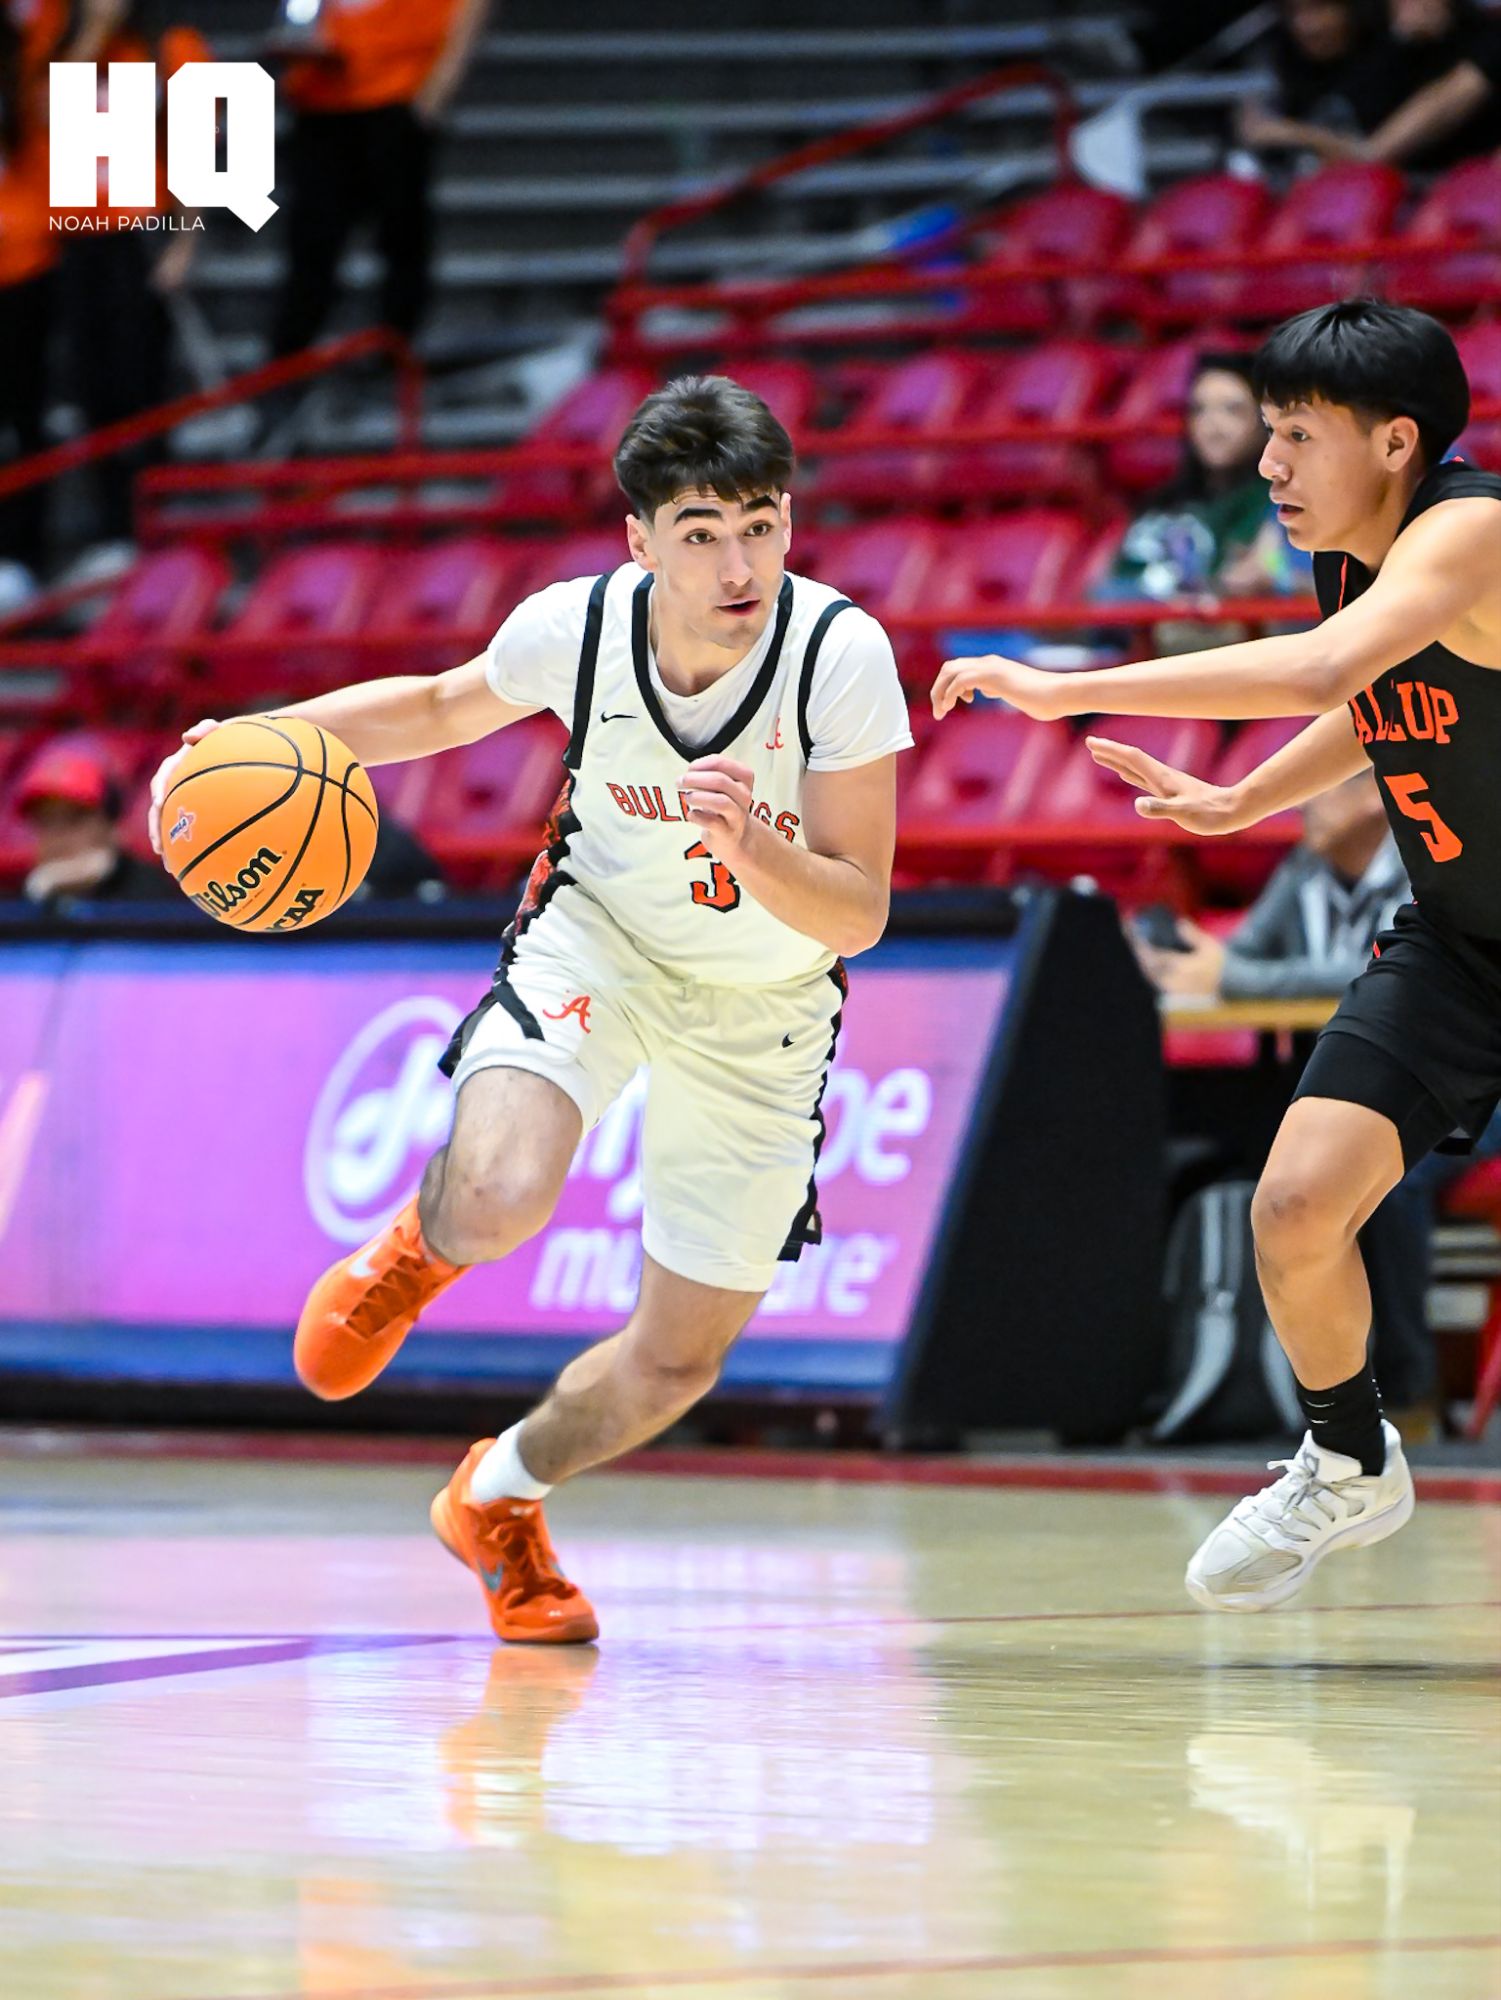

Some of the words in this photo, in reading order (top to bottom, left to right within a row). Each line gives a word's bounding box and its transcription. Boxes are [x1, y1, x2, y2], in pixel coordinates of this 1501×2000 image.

[1348, 680, 1459, 746] ALLUP
[606, 782, 800, 843] BULGS
[1383, 773, 1464, 863] 5
[684, 841, 741, 914] 3
[265, 889, 325, 932] CAA
[542, 995, 591, 1034] A
